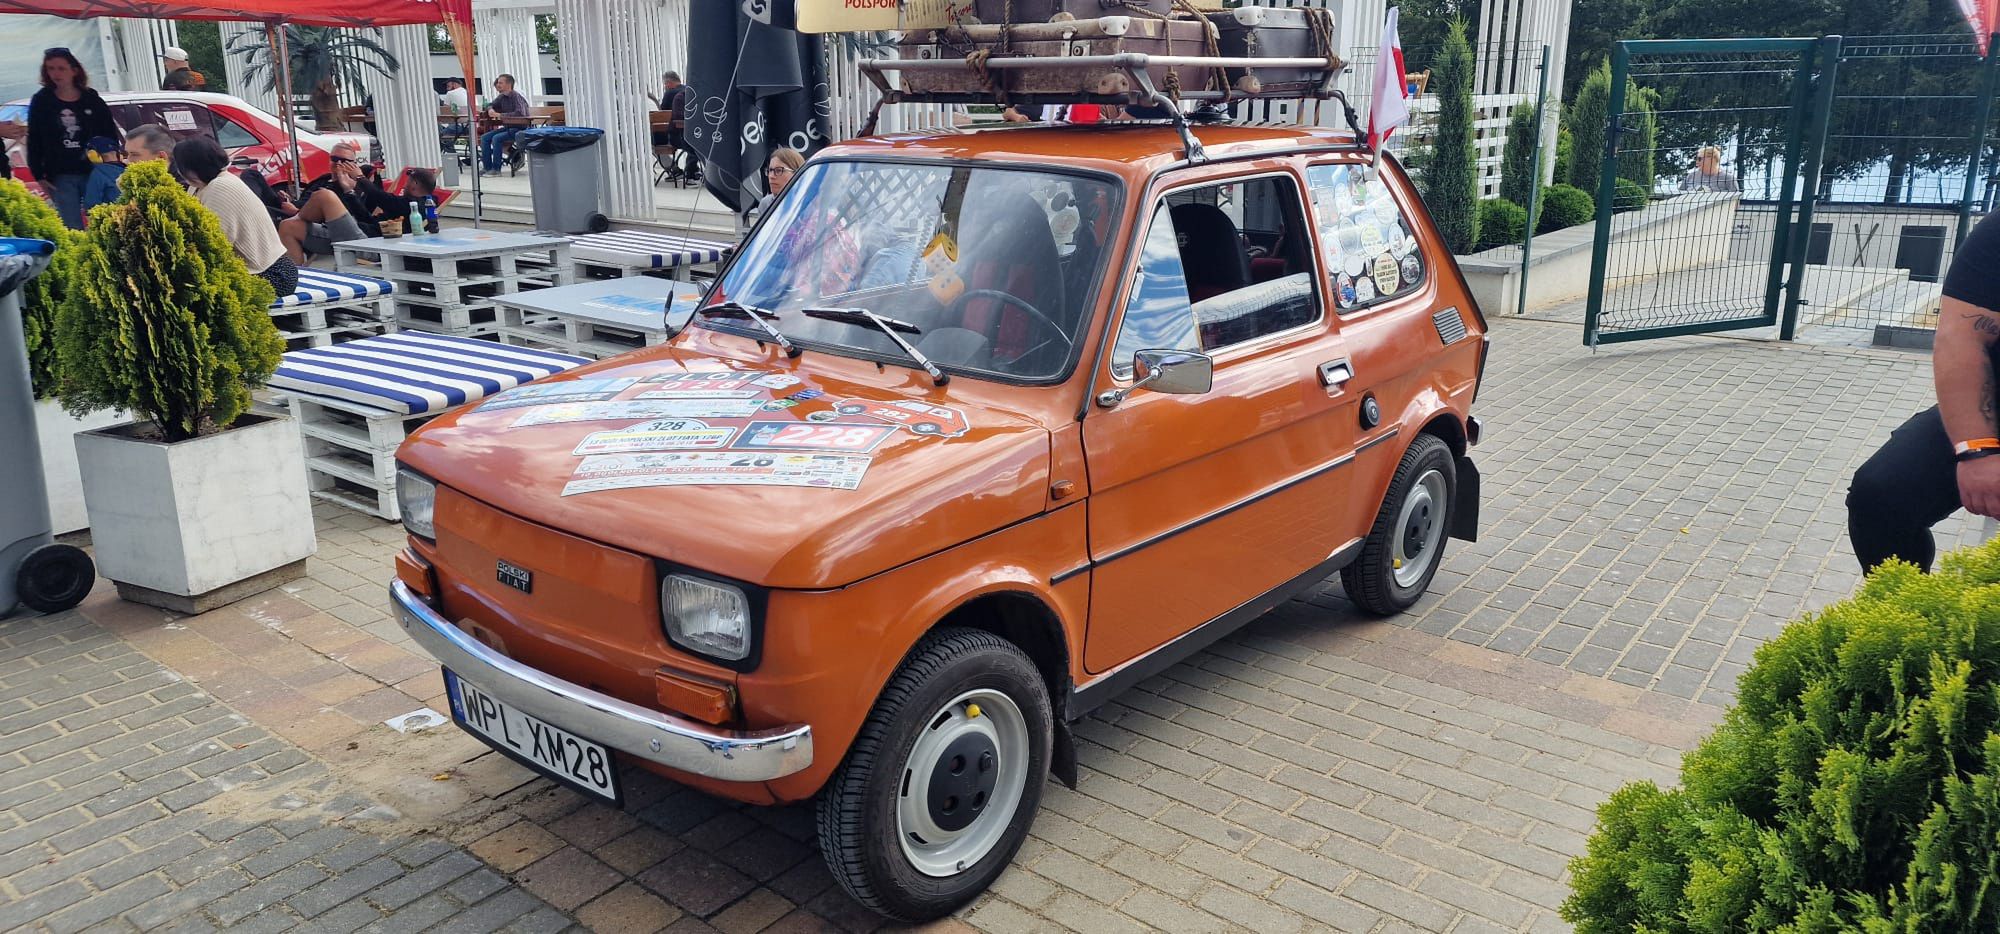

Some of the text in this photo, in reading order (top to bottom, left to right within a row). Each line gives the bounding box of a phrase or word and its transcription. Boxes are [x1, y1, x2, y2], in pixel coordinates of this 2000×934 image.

[873, 407, 912, 420] 282
[650, 421, 684, 432] 328
[773, 425, 874, 445] 228
[497, 562, 529, 581] POLSKI
[497, 571, 528, 590] FIAT
[461, 682, 609, 790] WPL XM28
